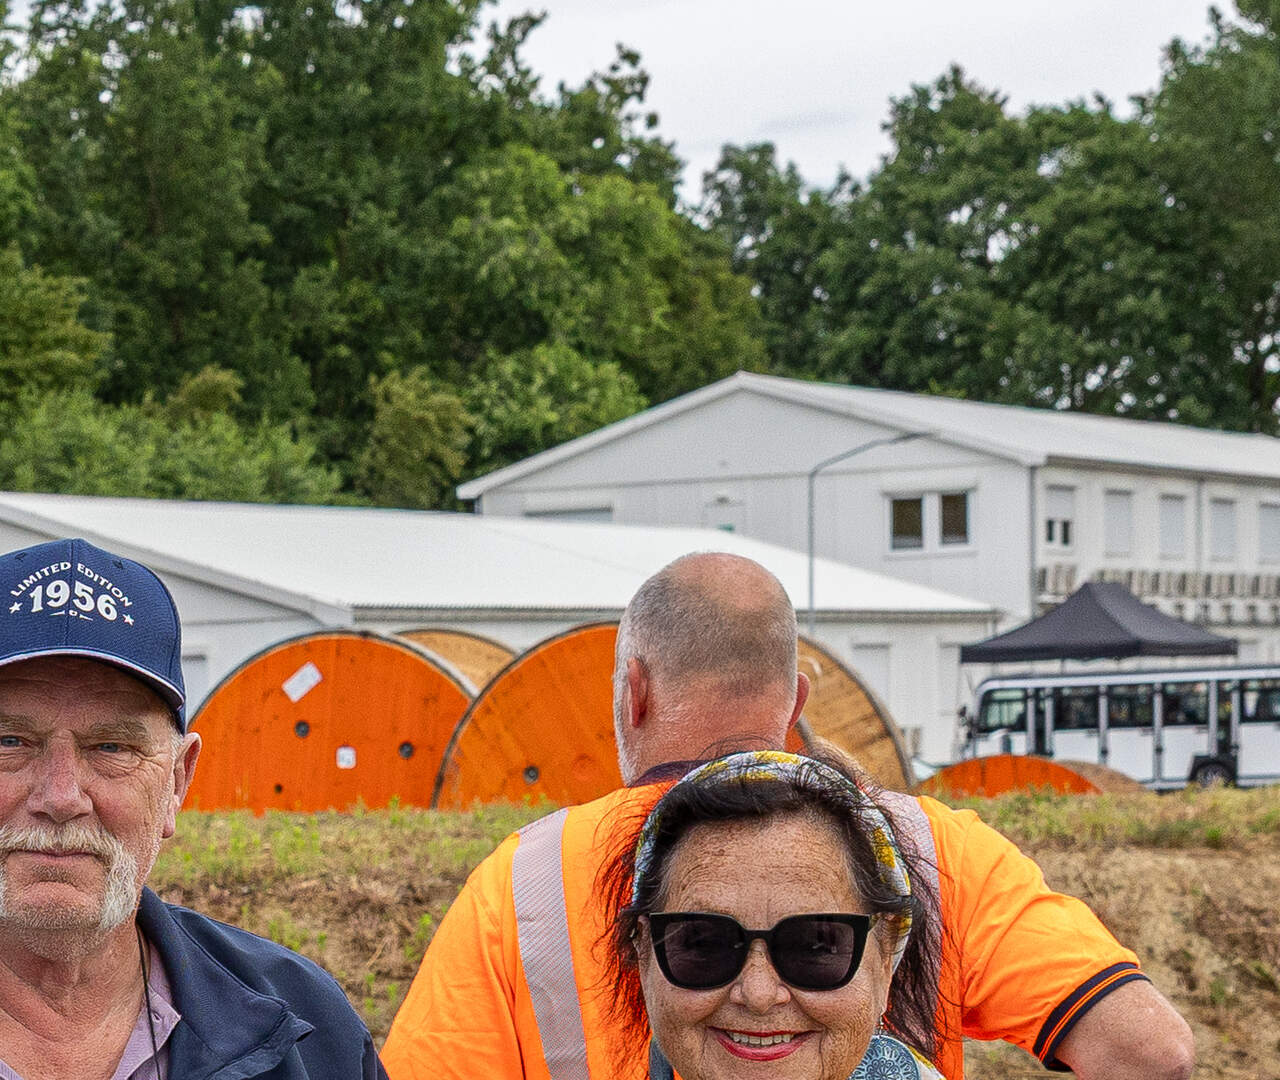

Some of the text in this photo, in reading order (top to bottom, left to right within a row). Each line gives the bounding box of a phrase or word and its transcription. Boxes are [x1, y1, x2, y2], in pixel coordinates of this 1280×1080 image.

[10, 561, 133, 607] LIMITED EDITION
[29, 579, 118, 621] 1956
